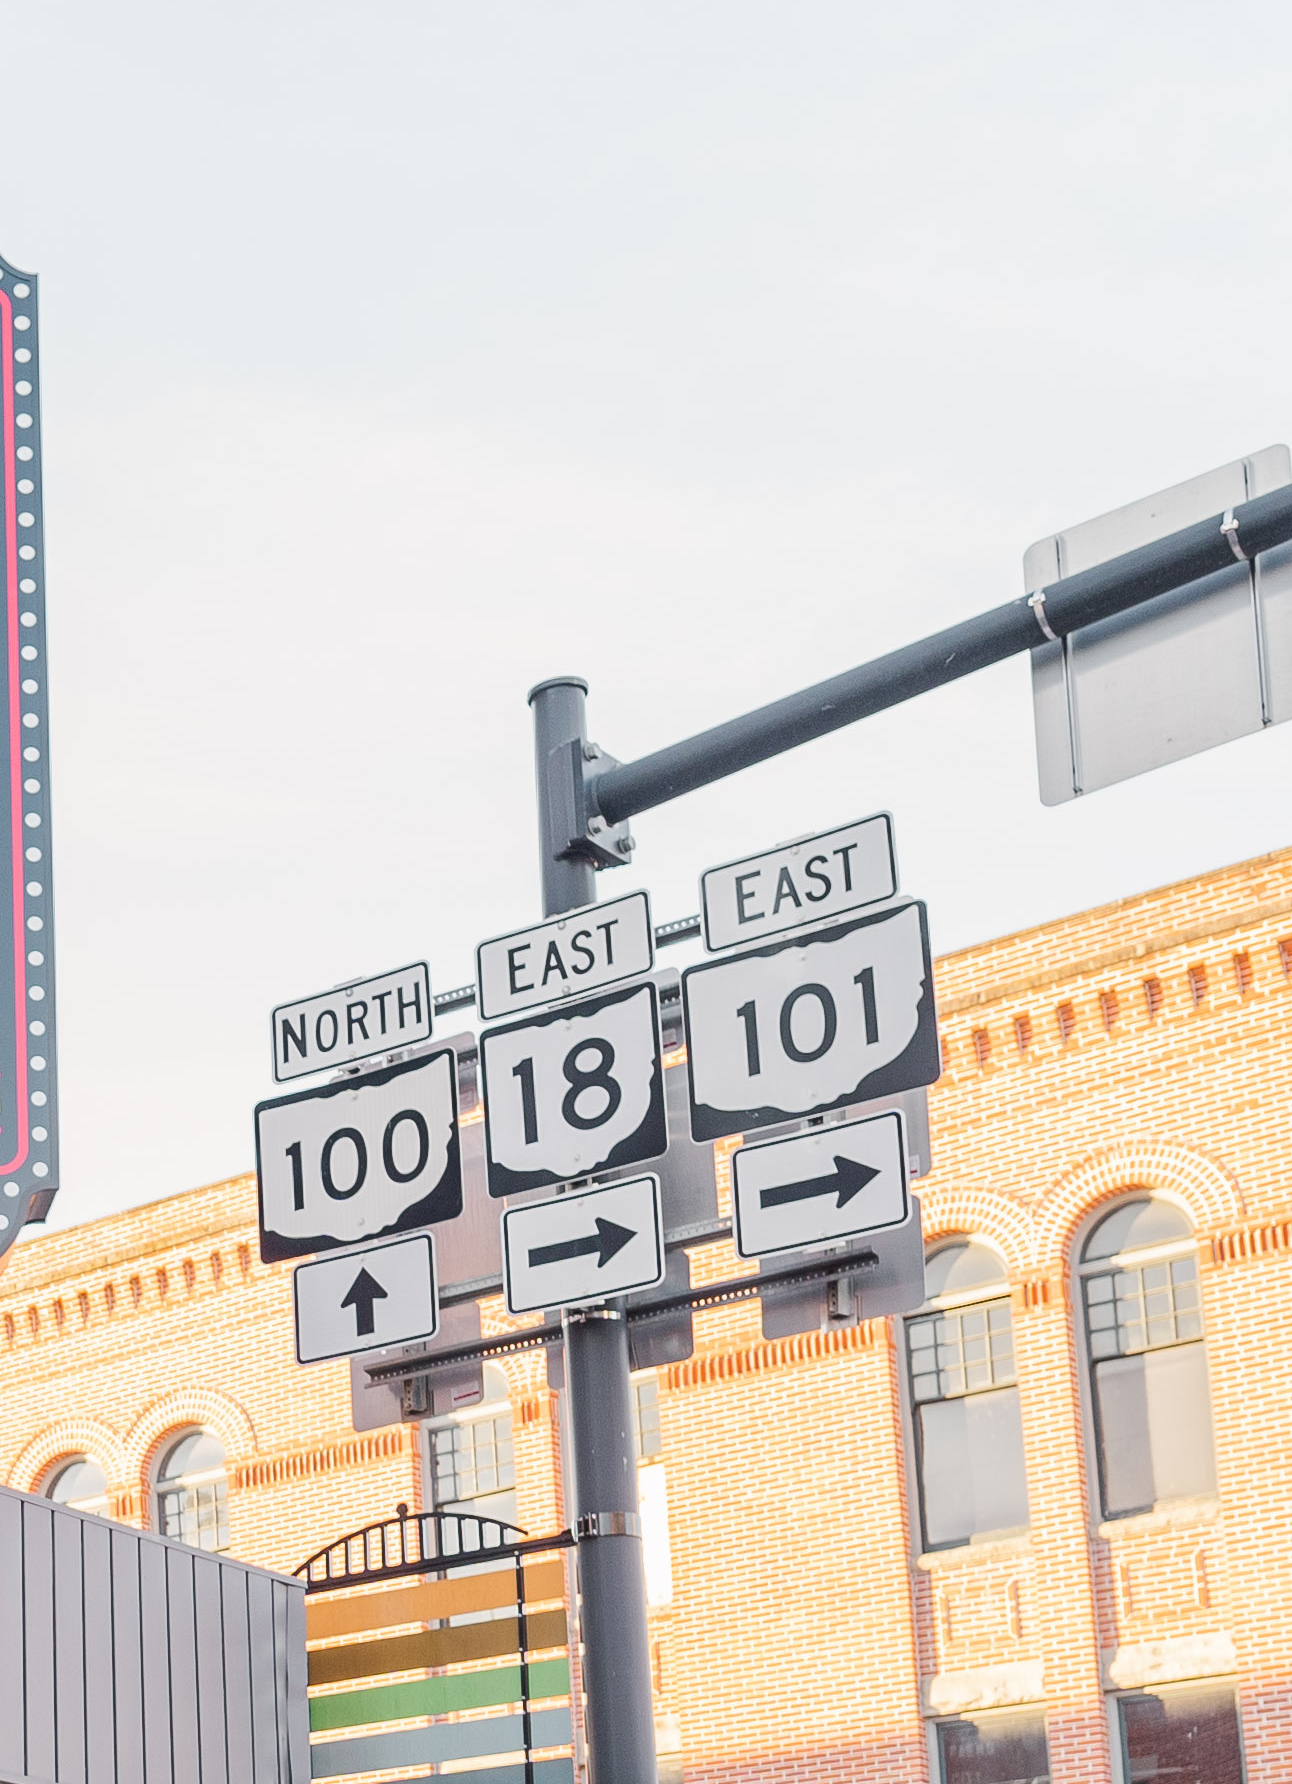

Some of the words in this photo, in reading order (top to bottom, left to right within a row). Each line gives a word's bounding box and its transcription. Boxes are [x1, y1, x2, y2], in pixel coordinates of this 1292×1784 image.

[734, 843, 859, 926] EAST
[507, 919, 620, 996] EAST
[281, 981, 424, 1064] NORTH
[736, 966, 881, 1077] 101
[512, 1037, 623, 1146] 18
[285, 1108, 430, 1212] 100
